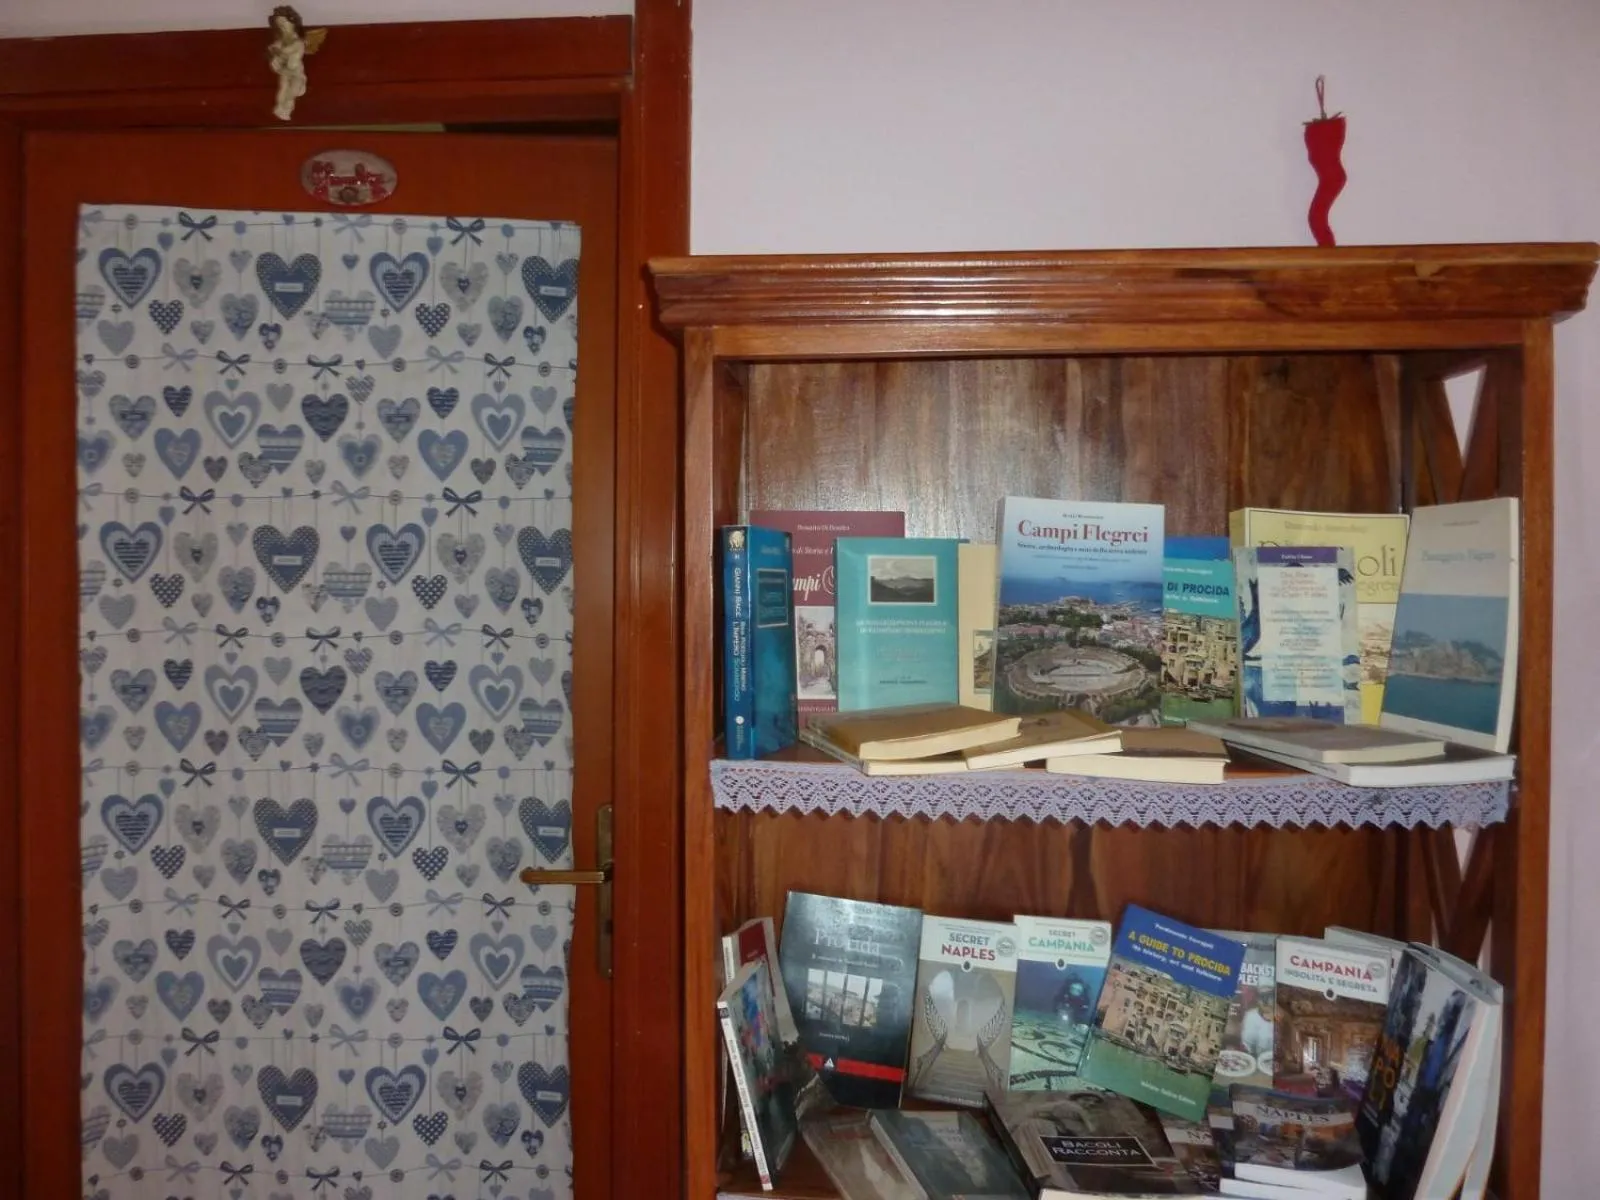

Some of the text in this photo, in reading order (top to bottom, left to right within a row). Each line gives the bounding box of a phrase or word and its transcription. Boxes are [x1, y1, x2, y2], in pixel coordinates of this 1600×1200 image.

[1017, 519, 1149, 547] Campi Flegrei
[1167, 582, 1230, 596] DI PROCIDA
[949, 932, 990, 946] SECRET
[1048, 929, 1076, 938] SECRET
[941, 944, 996, 961] NAPLES
[1028, 937, 1095, 952] CAMPANIA
[1128, 931, 1232, 976] A GUIDE TO PROCIDA
[1290, 955, 1373, 980] CAMPANIA
[1284, 968, 1326, 984] INSOLITA
[1336, 979, 1378, 993] SEGRETA
[1257, 1104, 1331, 1123] NAPLES
[1052, 1147, 1142, 1156] RACCONTA
[1061, 1140, 1122, 1149] BACOLI
